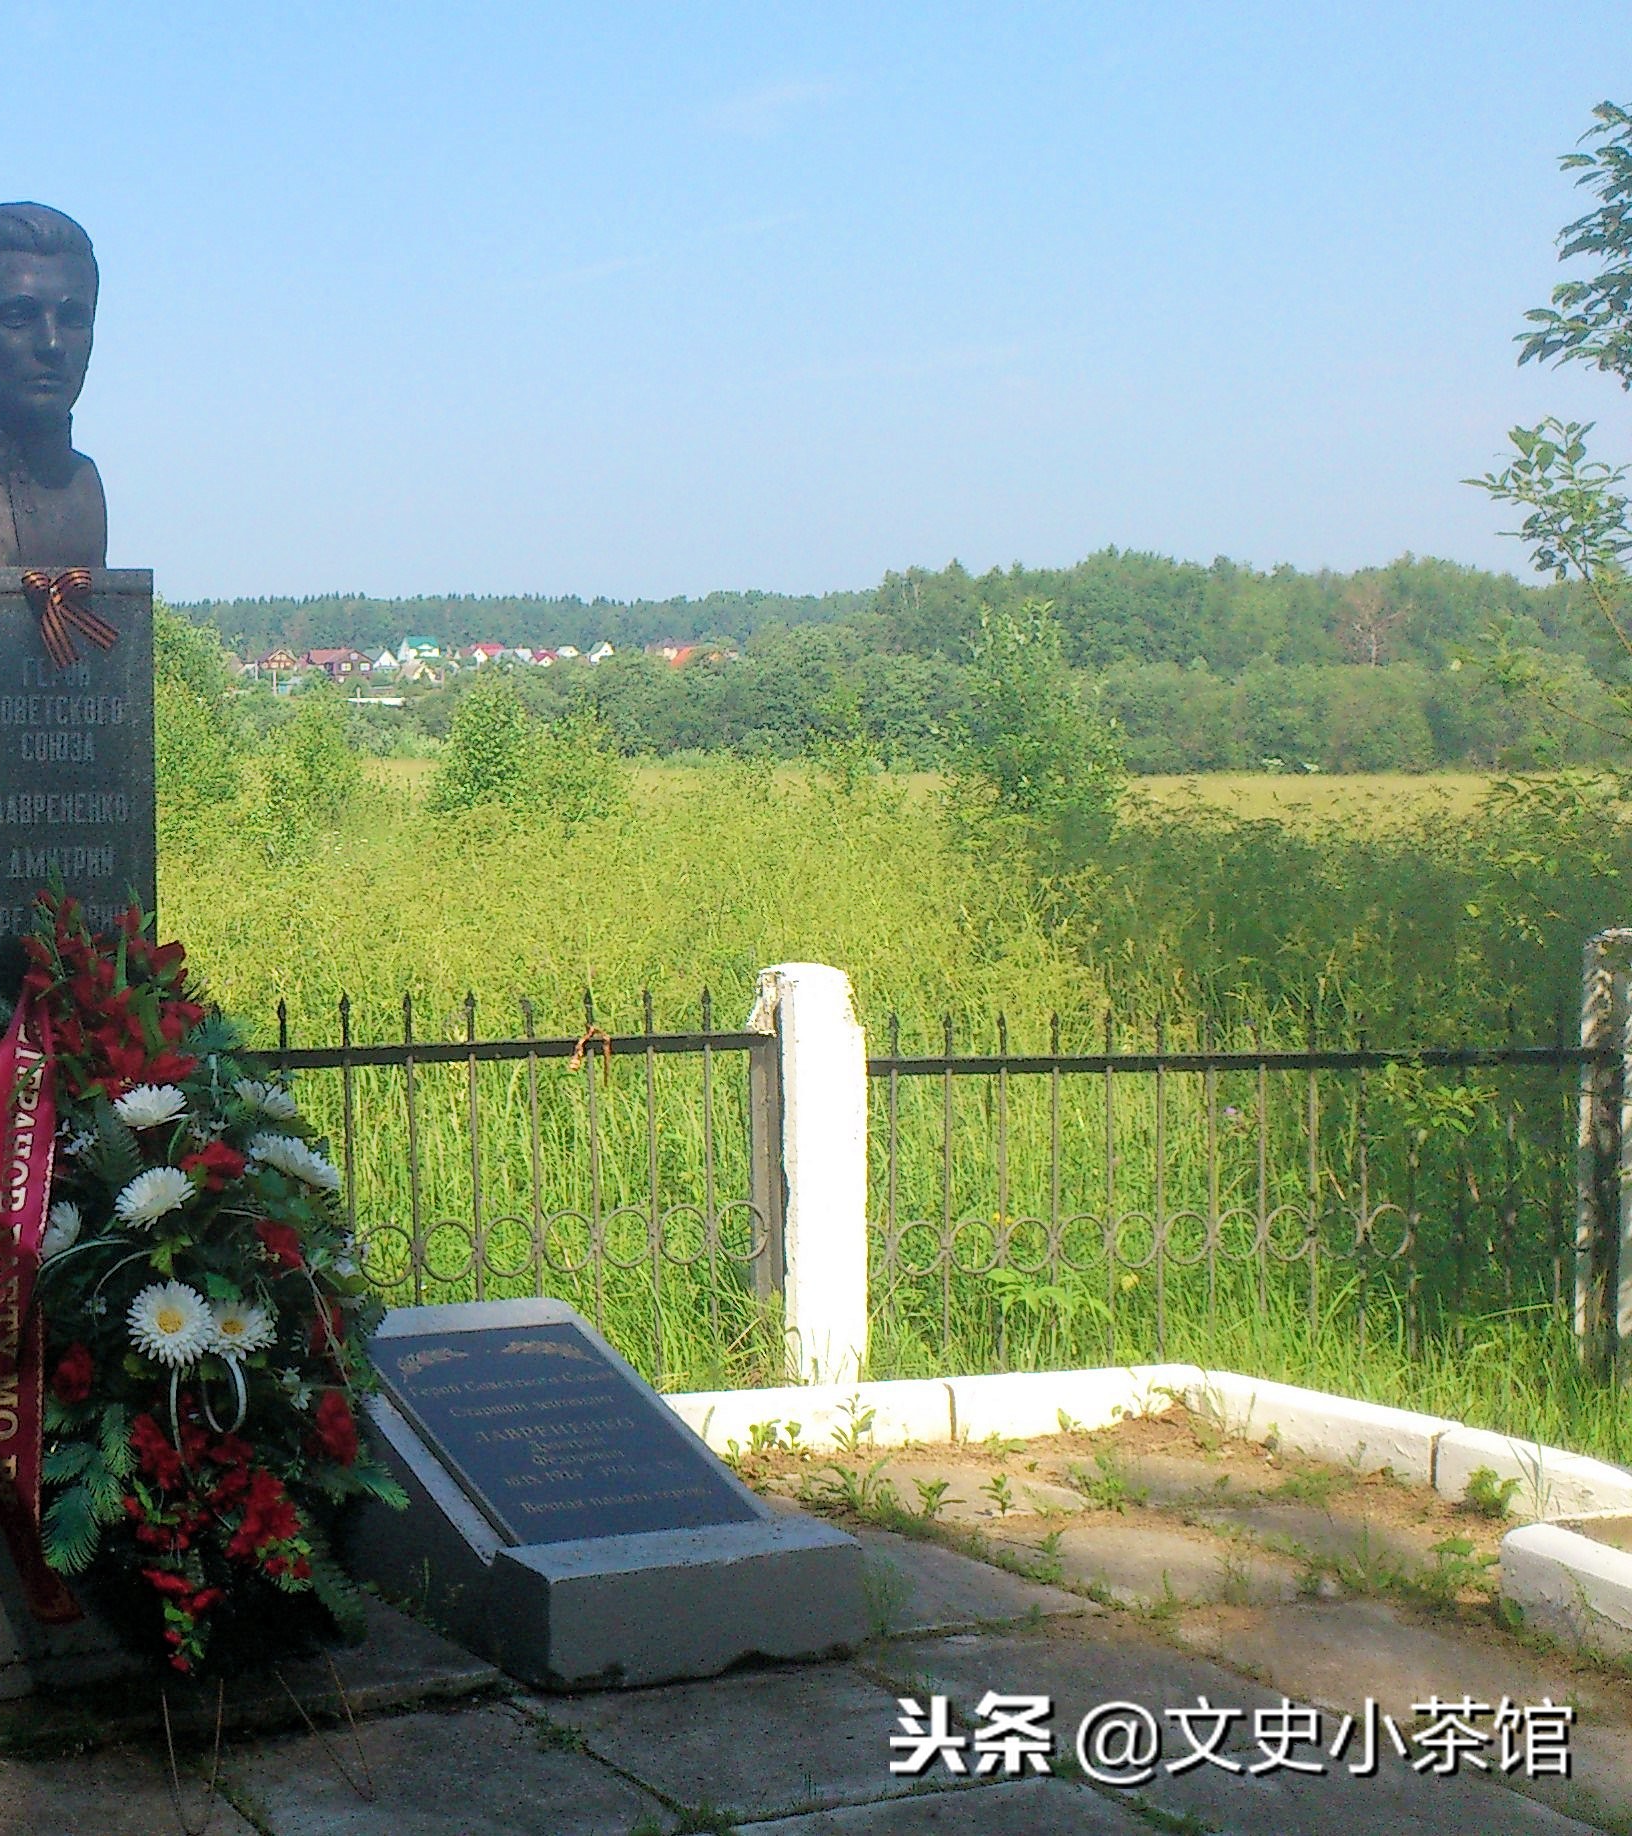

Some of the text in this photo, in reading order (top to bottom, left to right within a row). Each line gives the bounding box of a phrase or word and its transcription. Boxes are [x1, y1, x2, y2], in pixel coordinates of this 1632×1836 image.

[23, 657, 90, 687] ГЕОЙ
[22, 731, 95, 762] СОЮЗА
[6, 841, 115, 878] ДМИТРИЙ
